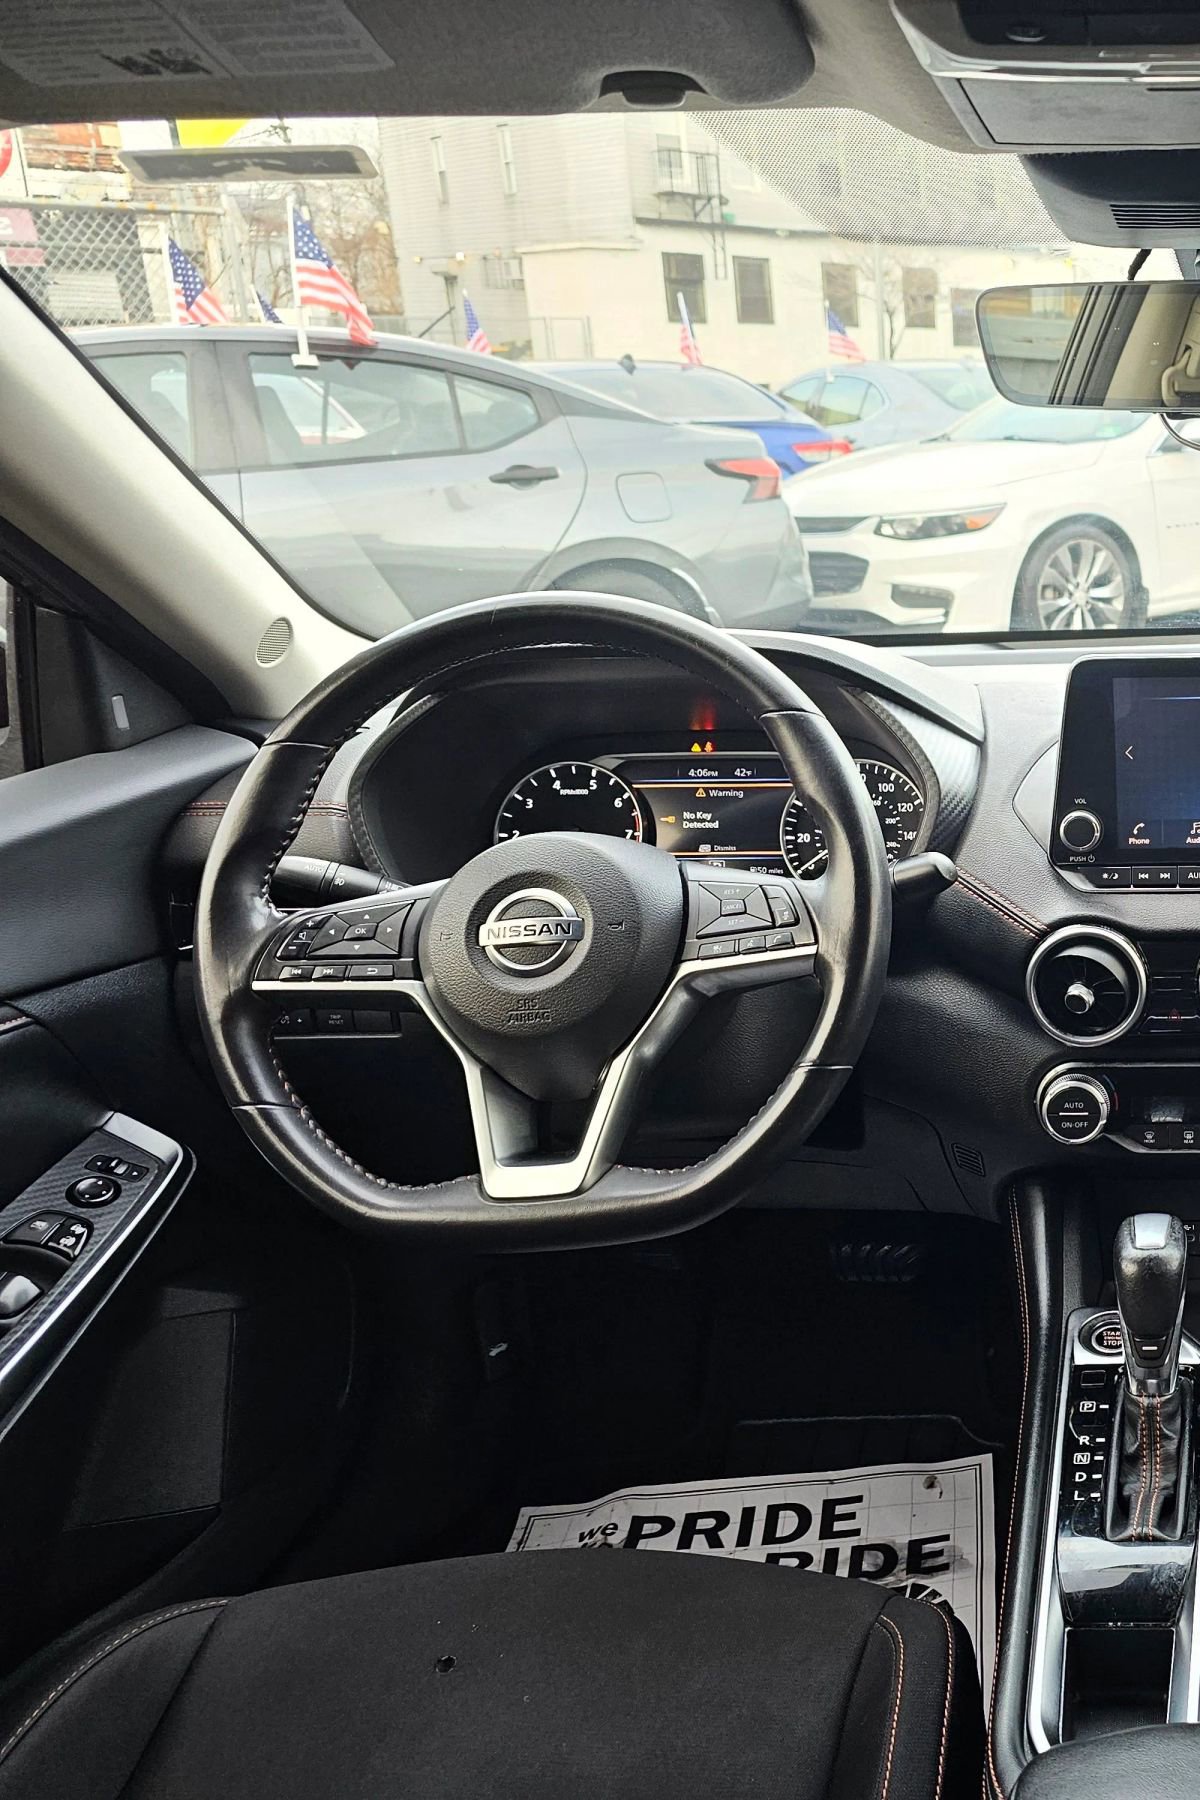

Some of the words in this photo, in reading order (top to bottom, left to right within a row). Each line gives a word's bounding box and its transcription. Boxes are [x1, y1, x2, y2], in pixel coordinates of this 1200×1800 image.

[552, 780, 561, 790] 4
[589, 780, 597, 790] 5
[877, 783, 895, 793] 100
[708, 789, 744, 798] Warning
[525, 798, 534, 809] 3
[614, 797, 623, 808] 6
[897, 803, 914, 813] 120
[682, 811, 695, 819] No
[697, 811, 712, 821] Key
[682, 820, 719, 829] Detected
[624, 829, 634, 840] 7
[797, 833, 811, 843] 20
[1128, 837, 1150, 845] Phone
[713, 844, 736, 852] Dismiss
[1069, 855, 1087, 863] PUSH
[354, 927, 367, 935] OK
[487, 922, 572, 941] NISSAN
[517, 998, 539, 1010] SRS
[508, 1010, 552, 1024] AIRBAG
[1079, 1435, 1090, 1445] R
[1075, 1472, 1087, 1482] D
[1074, 1490, 1085, 1500] L
[578, 1522, 619, 1543] we
[622, 1494, 864, 1550] PRIDE
